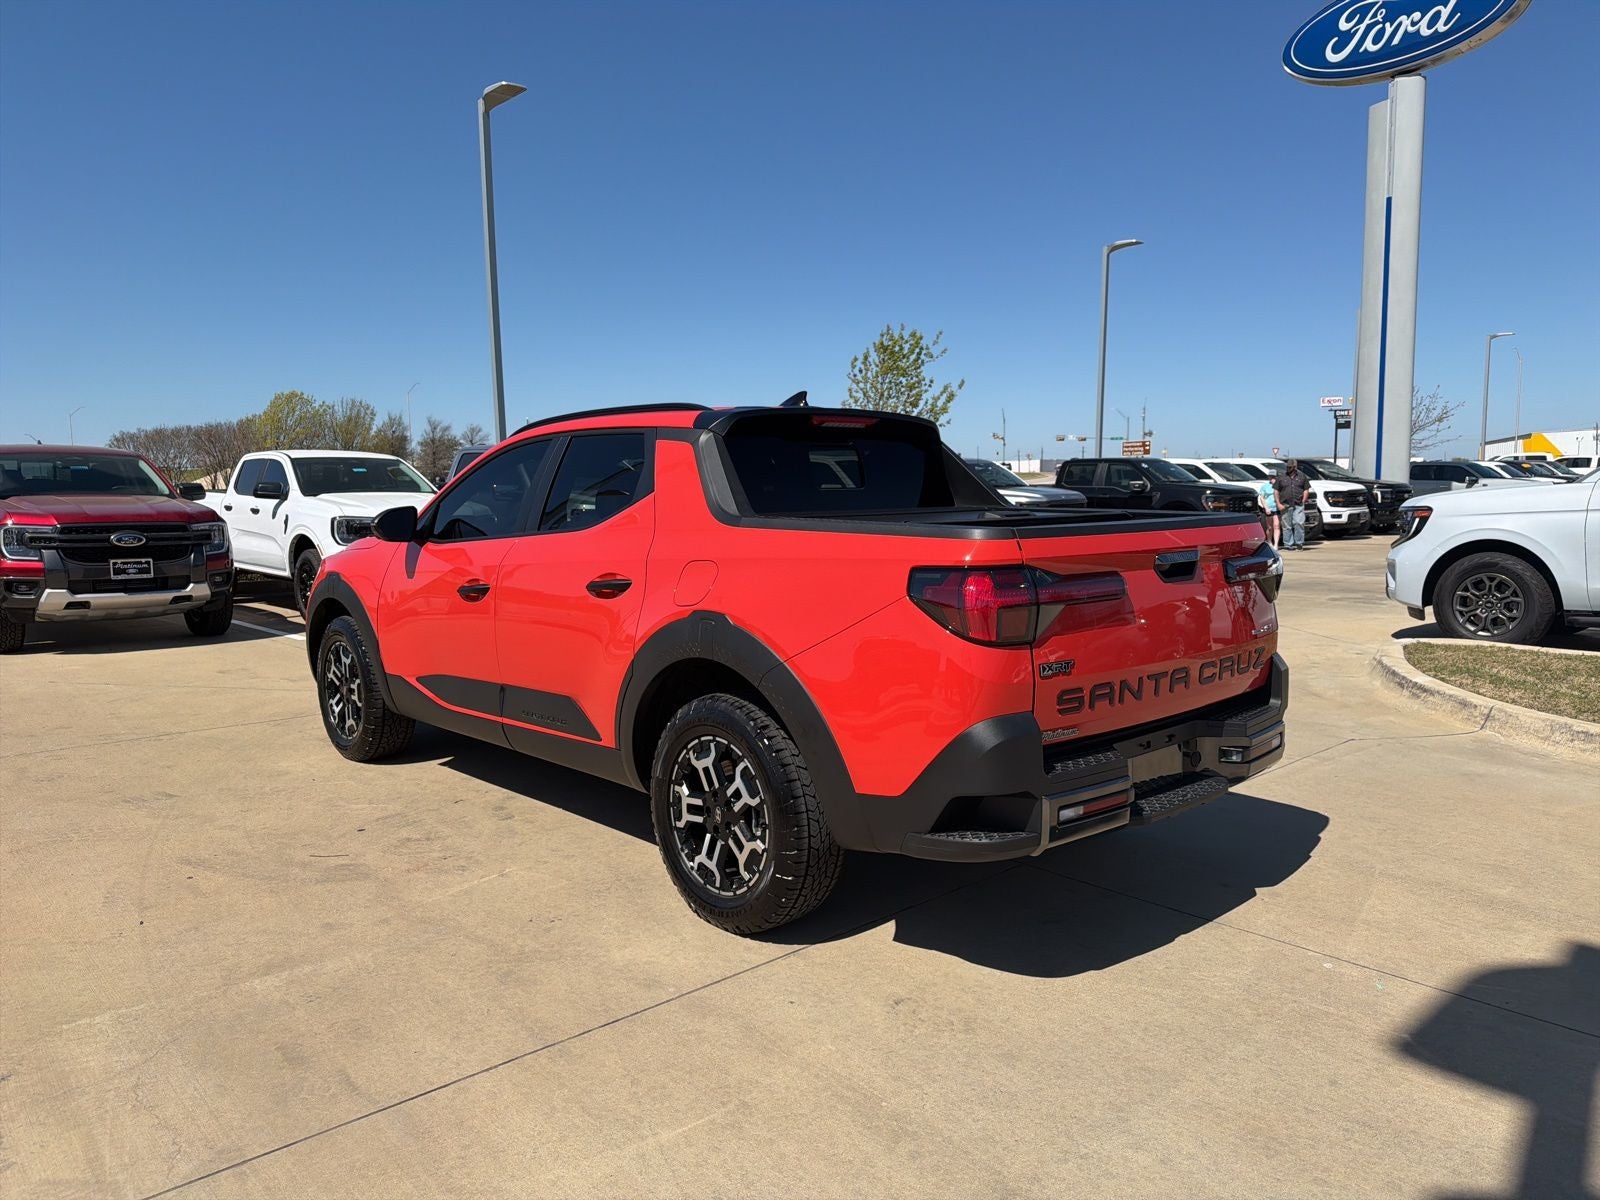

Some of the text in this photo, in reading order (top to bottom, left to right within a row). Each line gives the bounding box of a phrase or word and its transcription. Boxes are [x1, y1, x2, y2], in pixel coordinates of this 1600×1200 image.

[1325, 0, 1461, 63] Ford
[1040, 660, 1075, 679] XRT
[1056, 646, 1265, 716] SANTA CRUZ
